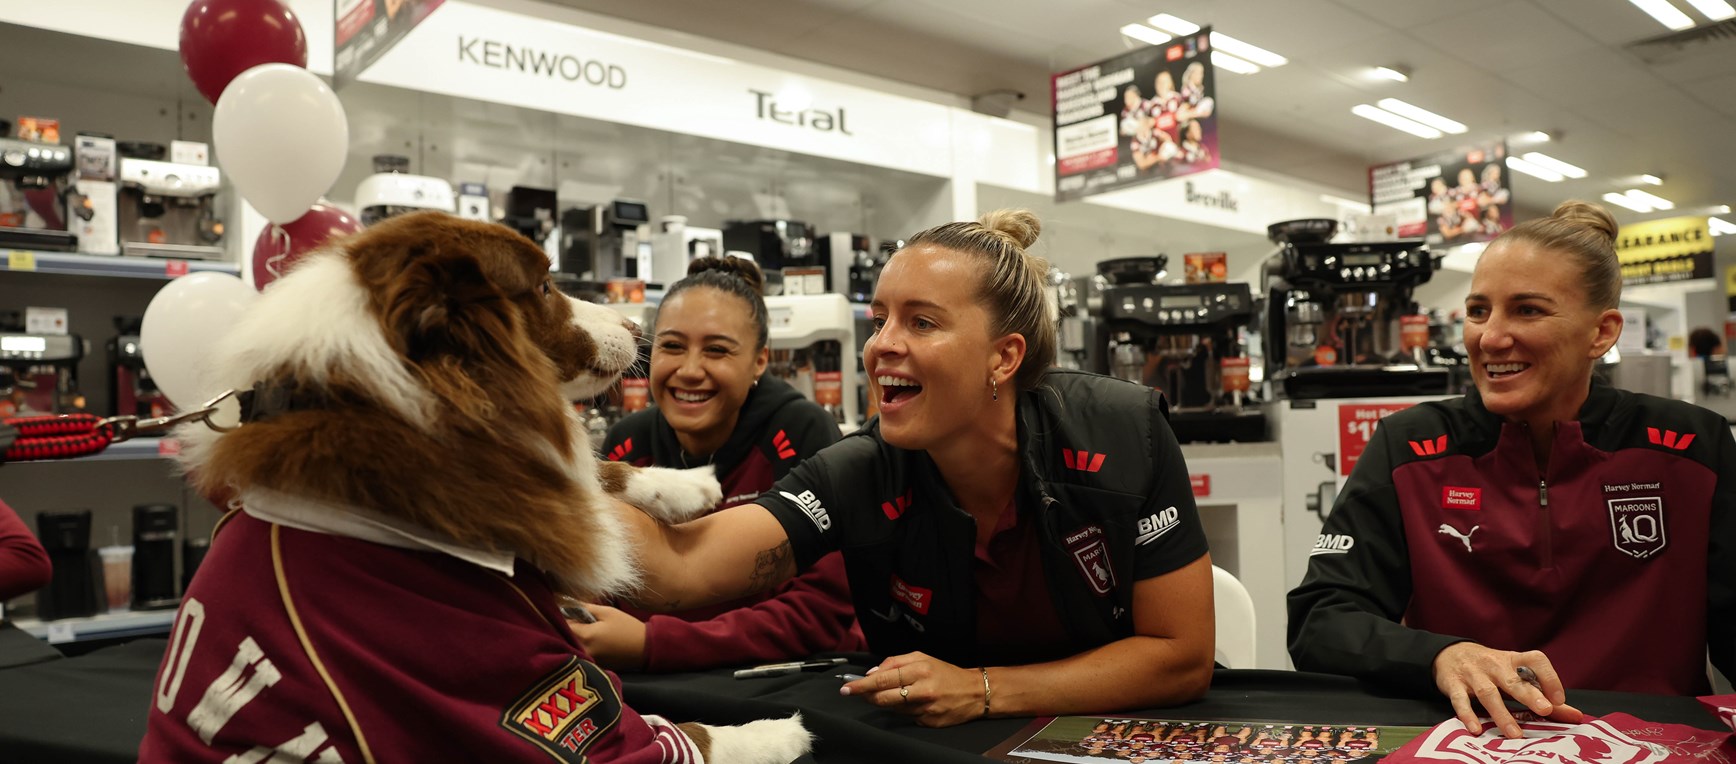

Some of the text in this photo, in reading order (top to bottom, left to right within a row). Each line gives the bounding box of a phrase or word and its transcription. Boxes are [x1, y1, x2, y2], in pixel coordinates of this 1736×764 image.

[458, 36, 627, 90] KENWOOD
[1449, 489, 1475, 500] Harvey
[1604, 482, 1660, 492] Harvey Norman
[1447, 496, 1476, 505] Norman
[1614, 503, 1657, 512] MAROONS
[798, 489, 832, 531] BMD
[1137, 506, 1179, 535] BMD
[1066, 529, 1089, 545] Harvey
[1313, 533, 1355, 550] BMD
